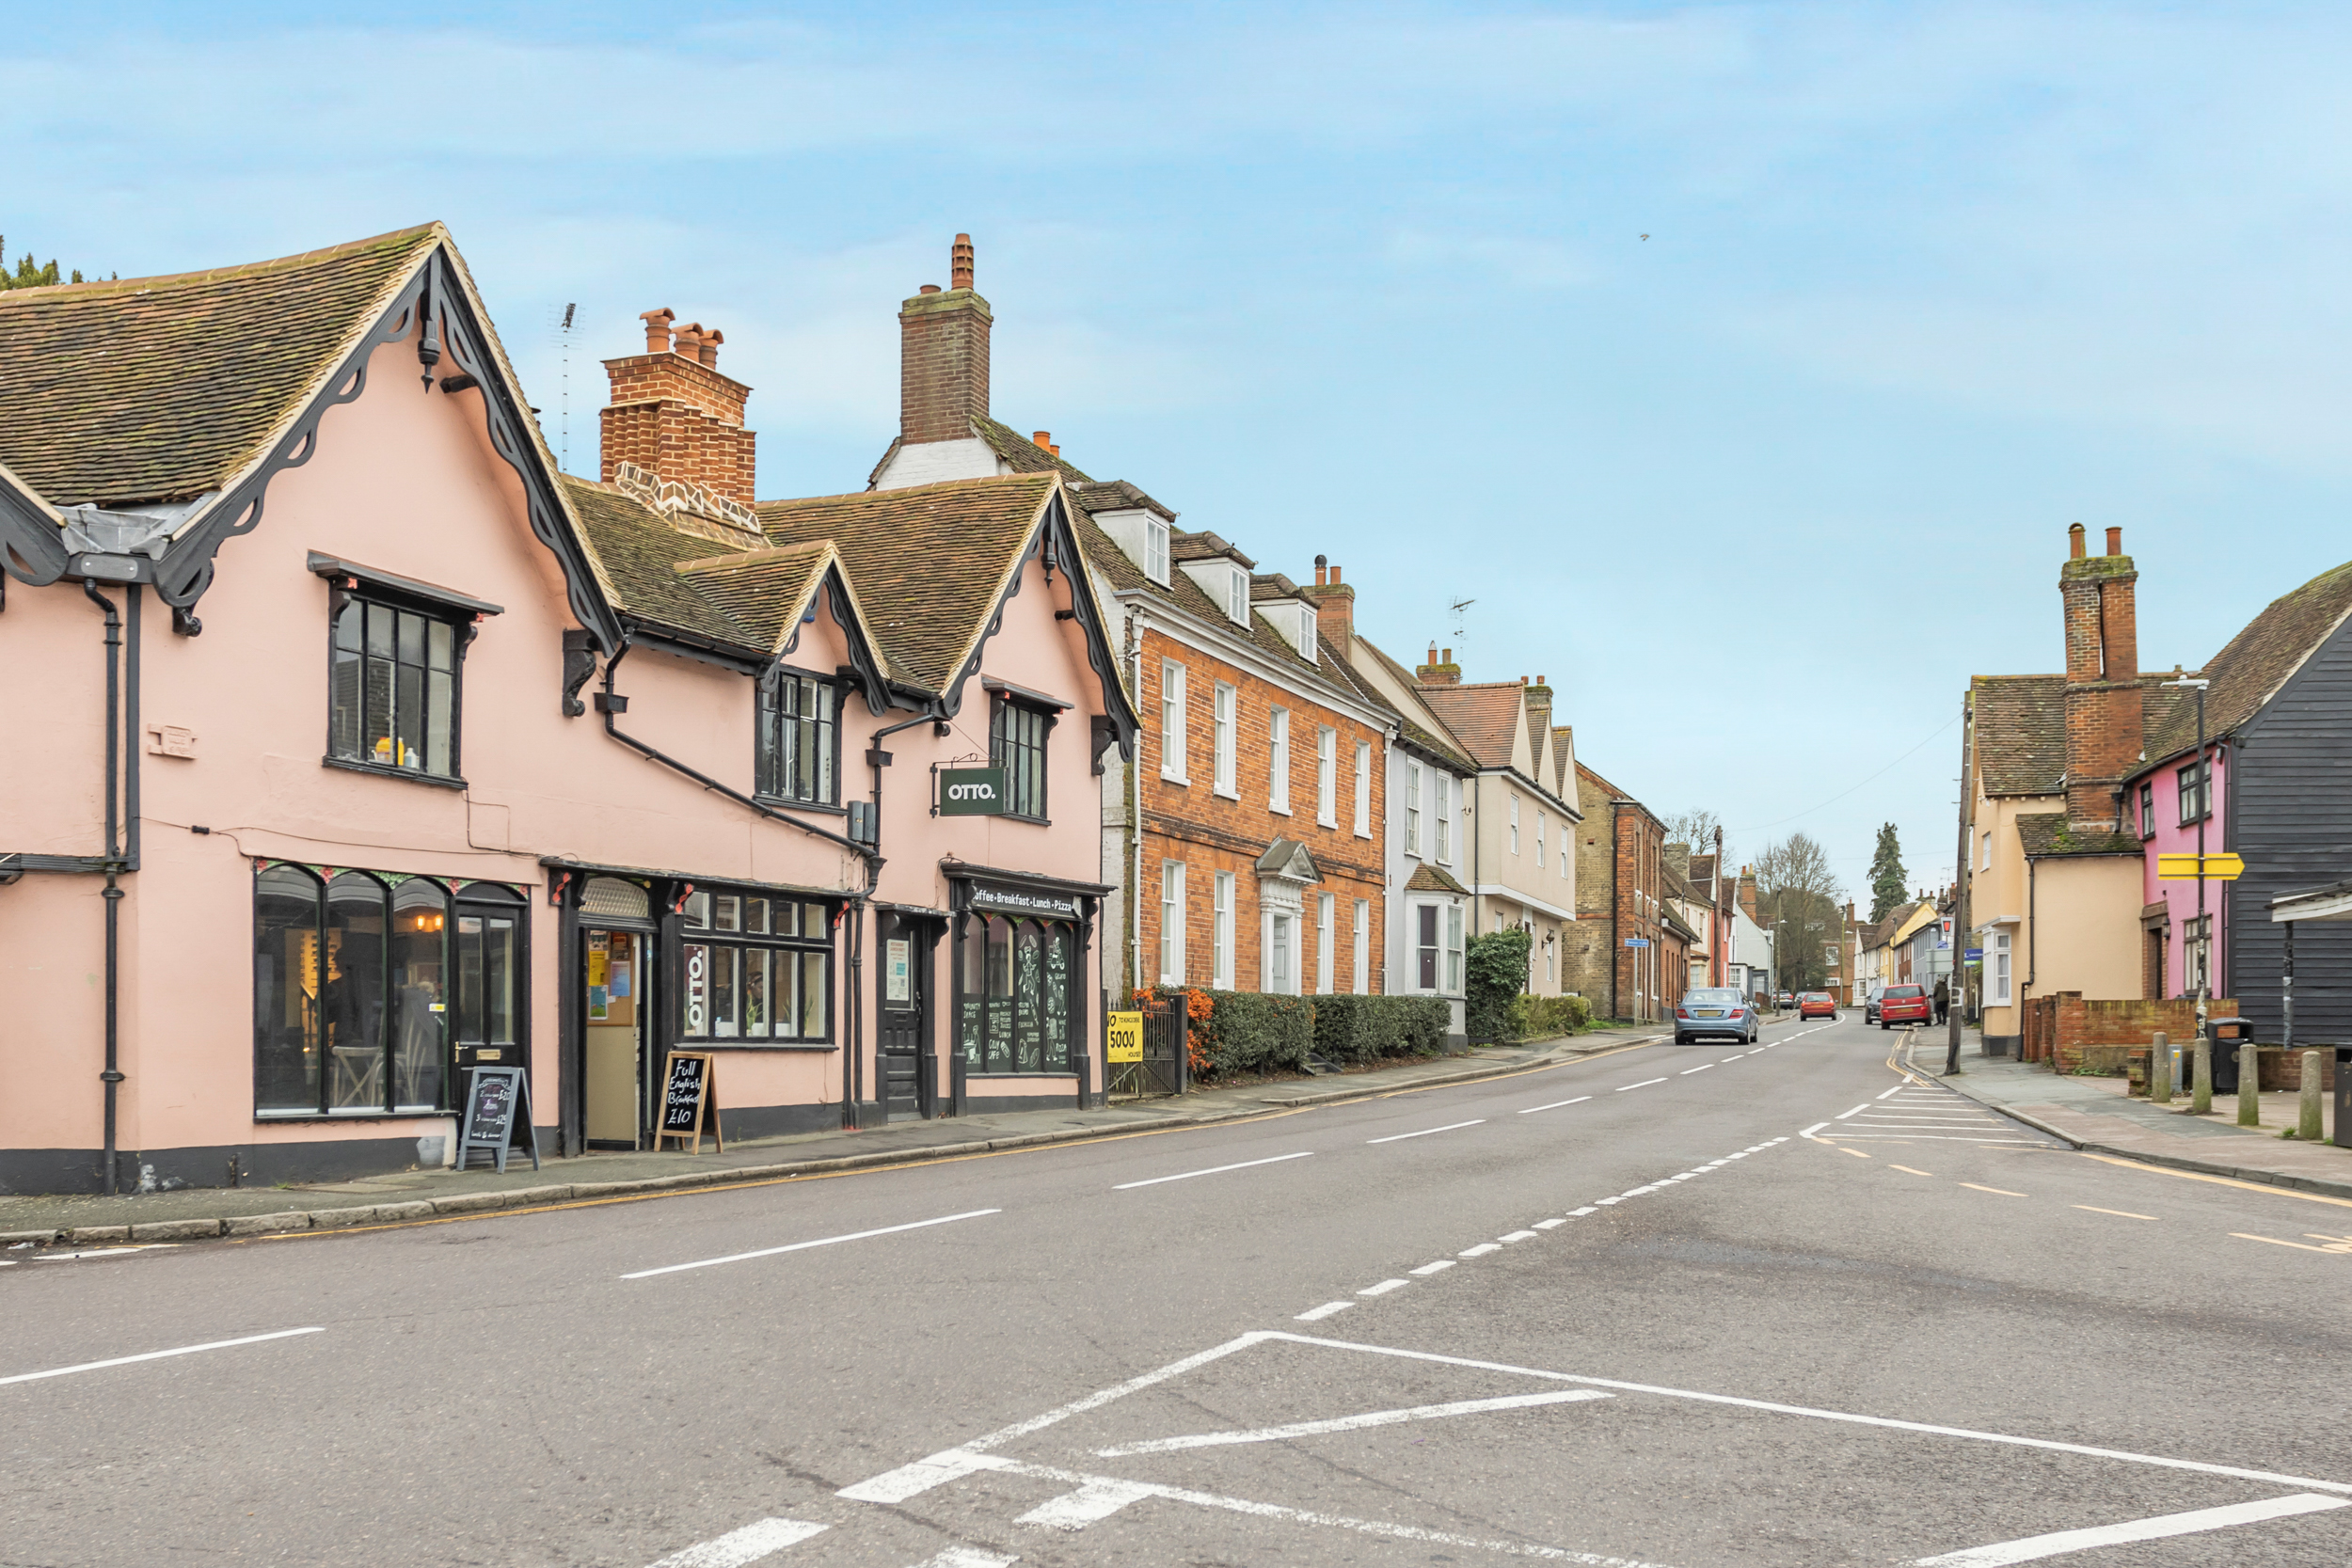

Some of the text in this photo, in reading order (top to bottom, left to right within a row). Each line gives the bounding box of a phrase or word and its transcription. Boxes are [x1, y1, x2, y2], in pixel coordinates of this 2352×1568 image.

[948, 784, 996, 800] OTTO.
[973, 889, 1072, 911] offee Breakfast Lunch Pizza
[689, 950, 703, 1027] OTTO.
[1110, 1031, 1134, 1048] 5000
[675, 1059, 696, 1077] Full
[669, 1076, 701, 1094] English
[667, 1108, 691, 1125] £10
